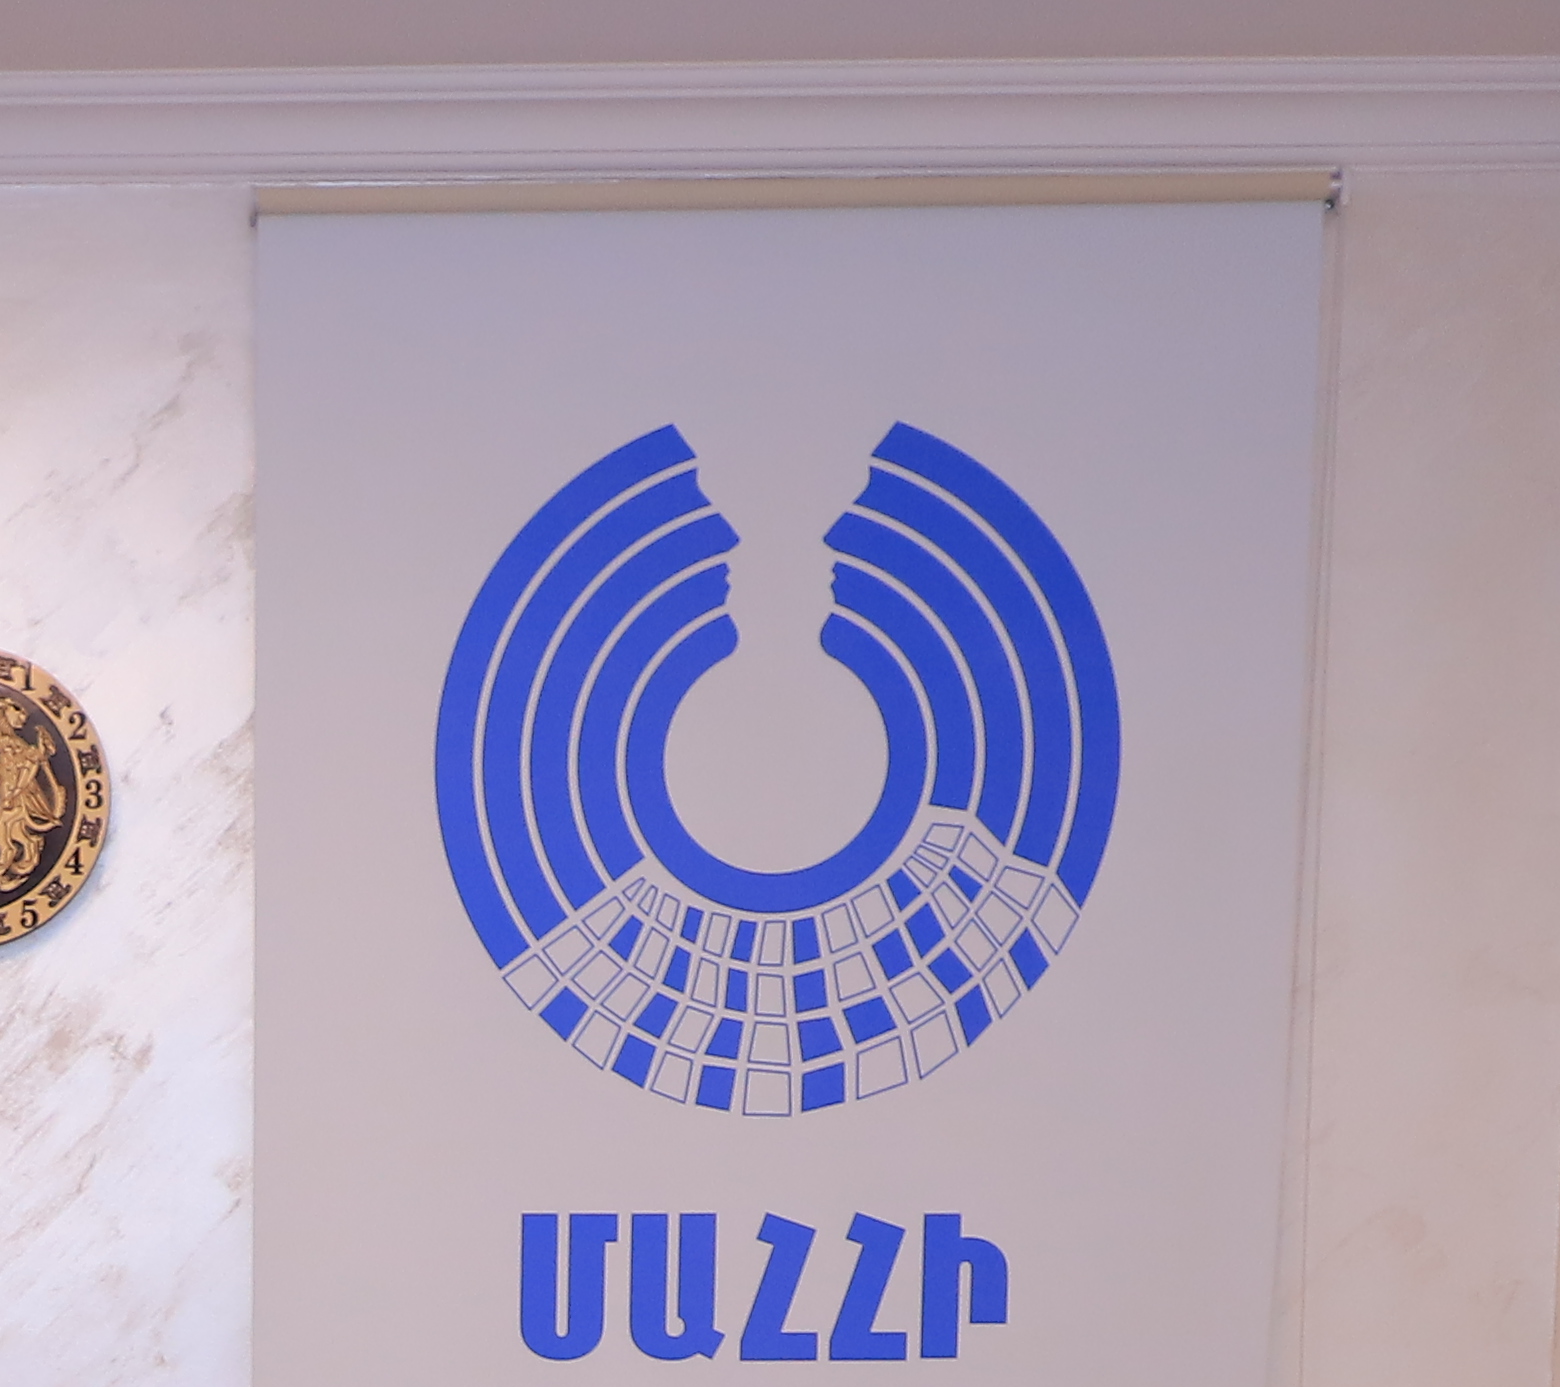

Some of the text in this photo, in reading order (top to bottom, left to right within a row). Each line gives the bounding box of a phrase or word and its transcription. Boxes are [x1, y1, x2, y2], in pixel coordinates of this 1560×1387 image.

[21, 662, 36, 690] 1
[69, 712, 87, 740] 2
[85, 782, 103, 809] 3
[65, 852, 84, 875] 4
[21, 901, 39, 928] 5
[519, 1212, 1008, 1361] ՄԱՀՀԻ
